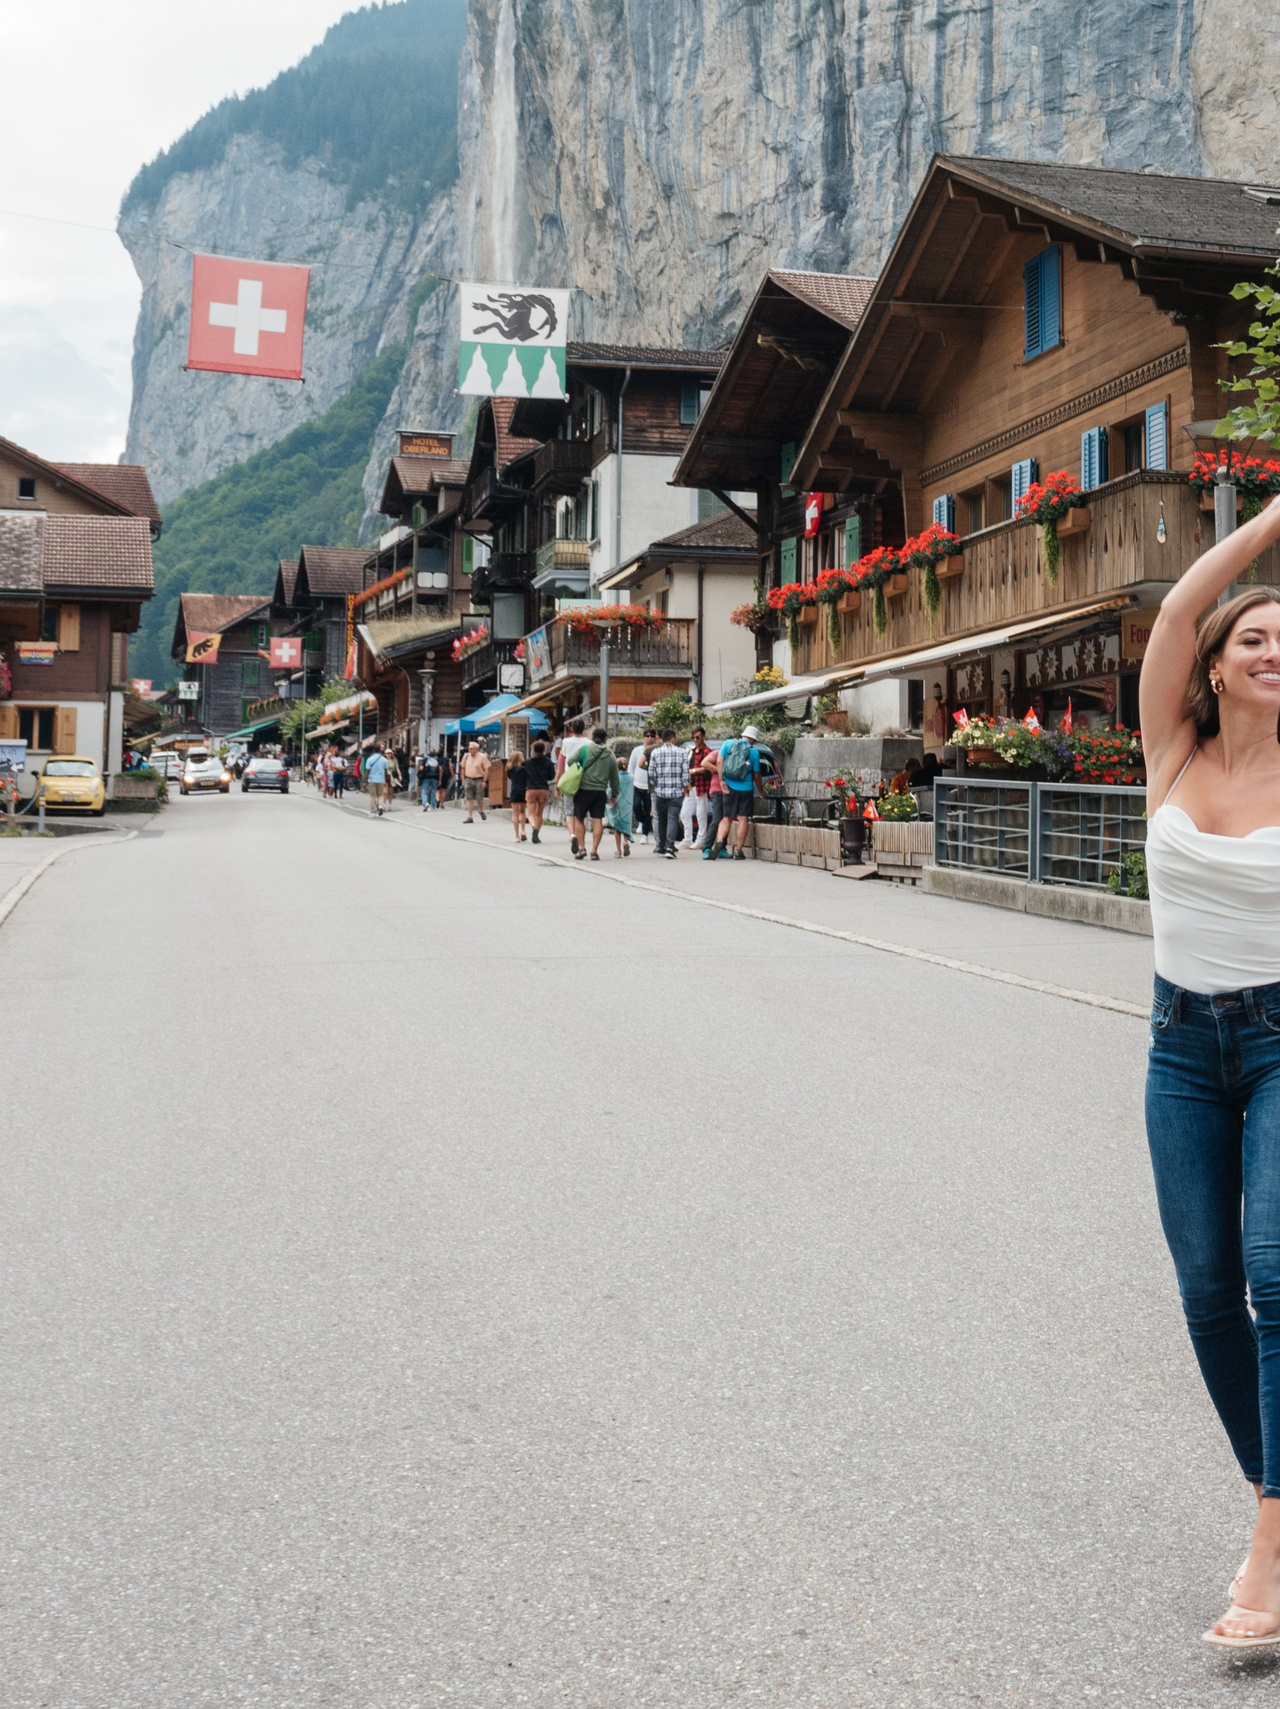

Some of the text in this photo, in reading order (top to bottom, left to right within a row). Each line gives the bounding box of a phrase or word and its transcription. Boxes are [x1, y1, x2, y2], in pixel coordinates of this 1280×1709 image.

[412, 438, 439, 446] HOTEL
[403, 445, 448, 455] OBERLAND
[347, 593, 355, 622] HOTEL
[1130, 624, 1150, 643] Foo
